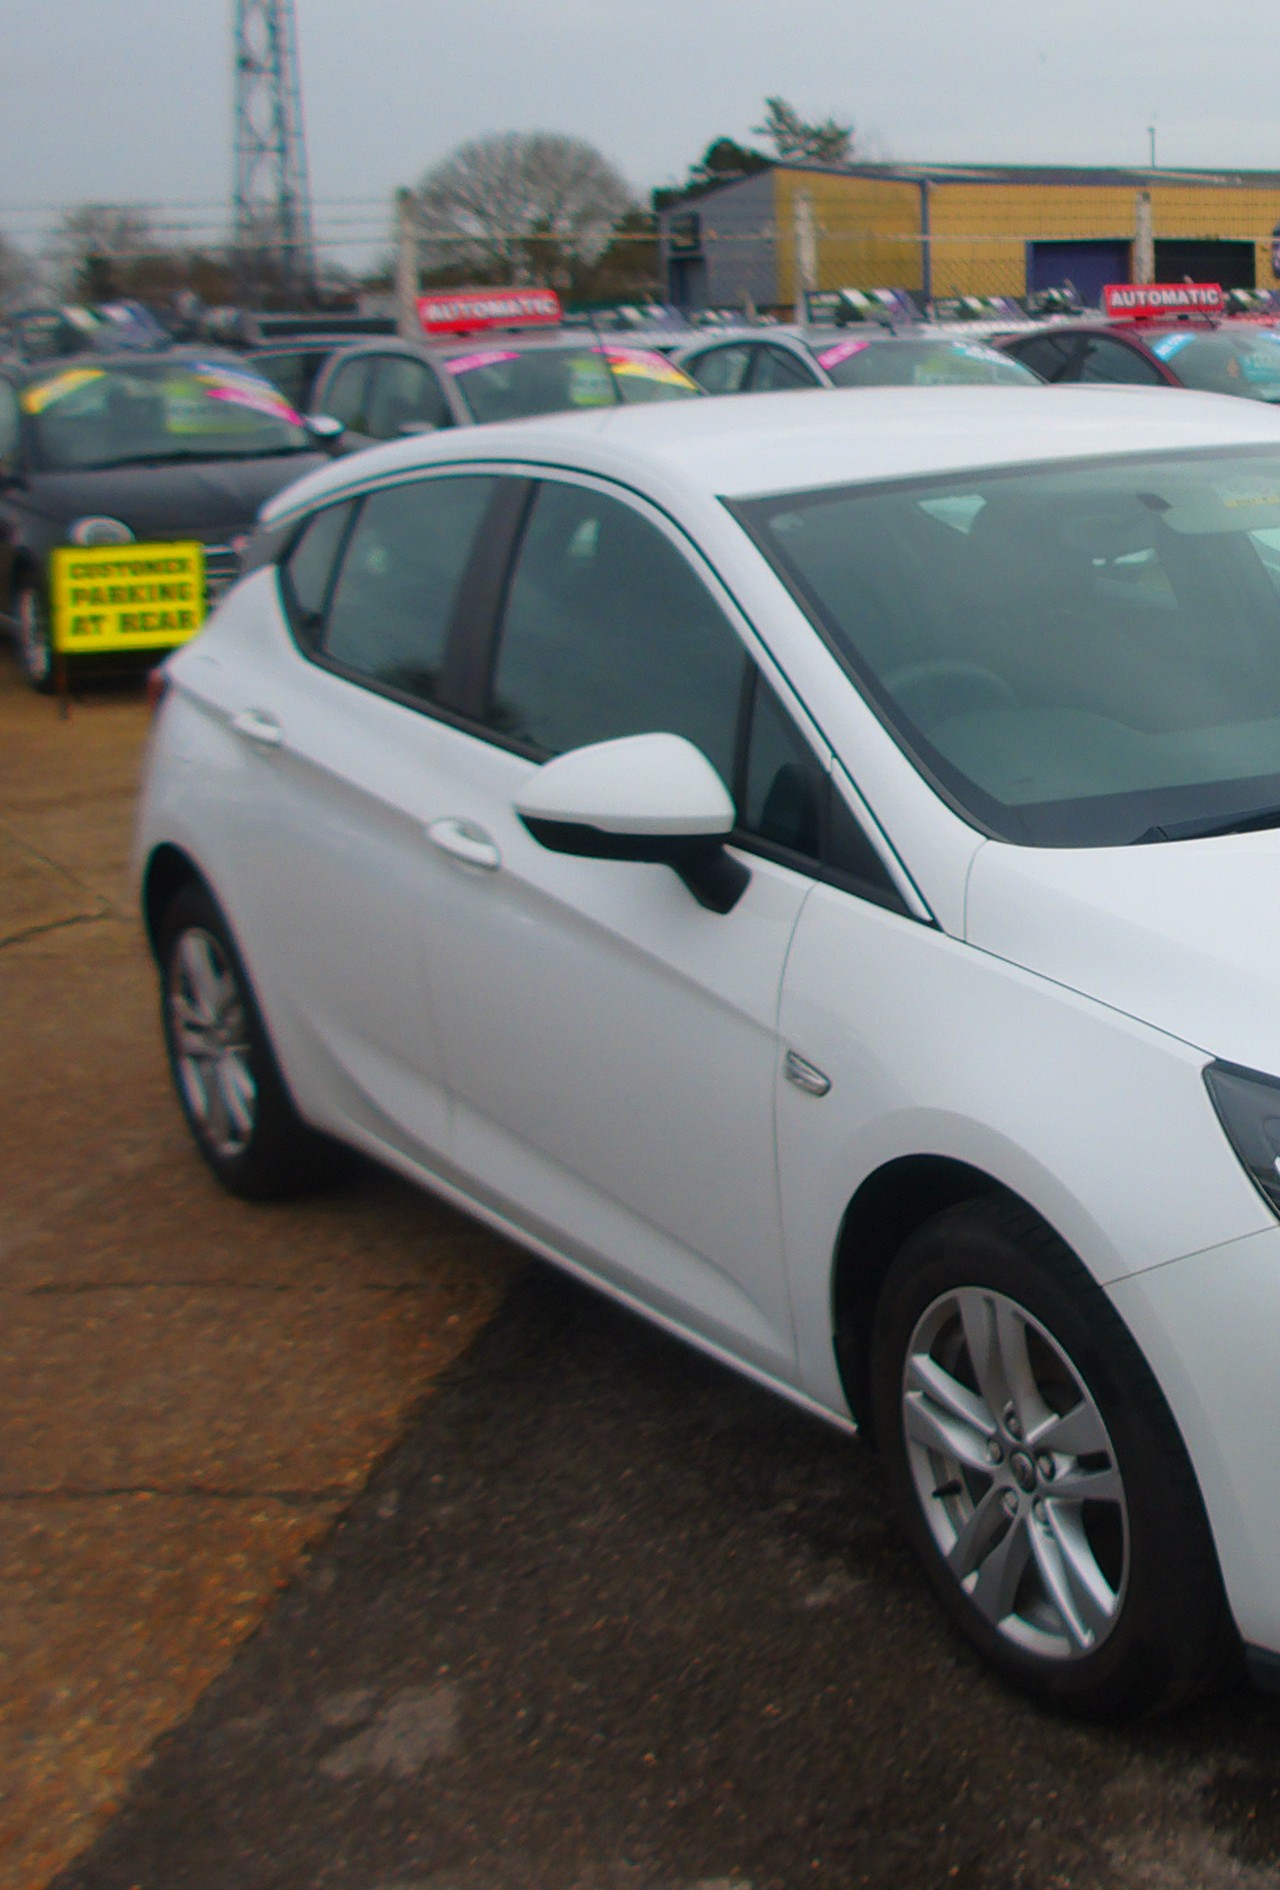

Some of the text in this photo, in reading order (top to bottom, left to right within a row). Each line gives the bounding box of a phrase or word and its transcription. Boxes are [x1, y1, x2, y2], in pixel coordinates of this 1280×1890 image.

[424, 297, 557, 321] AUTOMATIC
[1111, 289, 1218, 307] AUTOMATIC
[70, 558, 189, 580] CUSTOMER
[70, 582, 193, 608] PARKING
[71, 610, 193, 636] AT REAR
